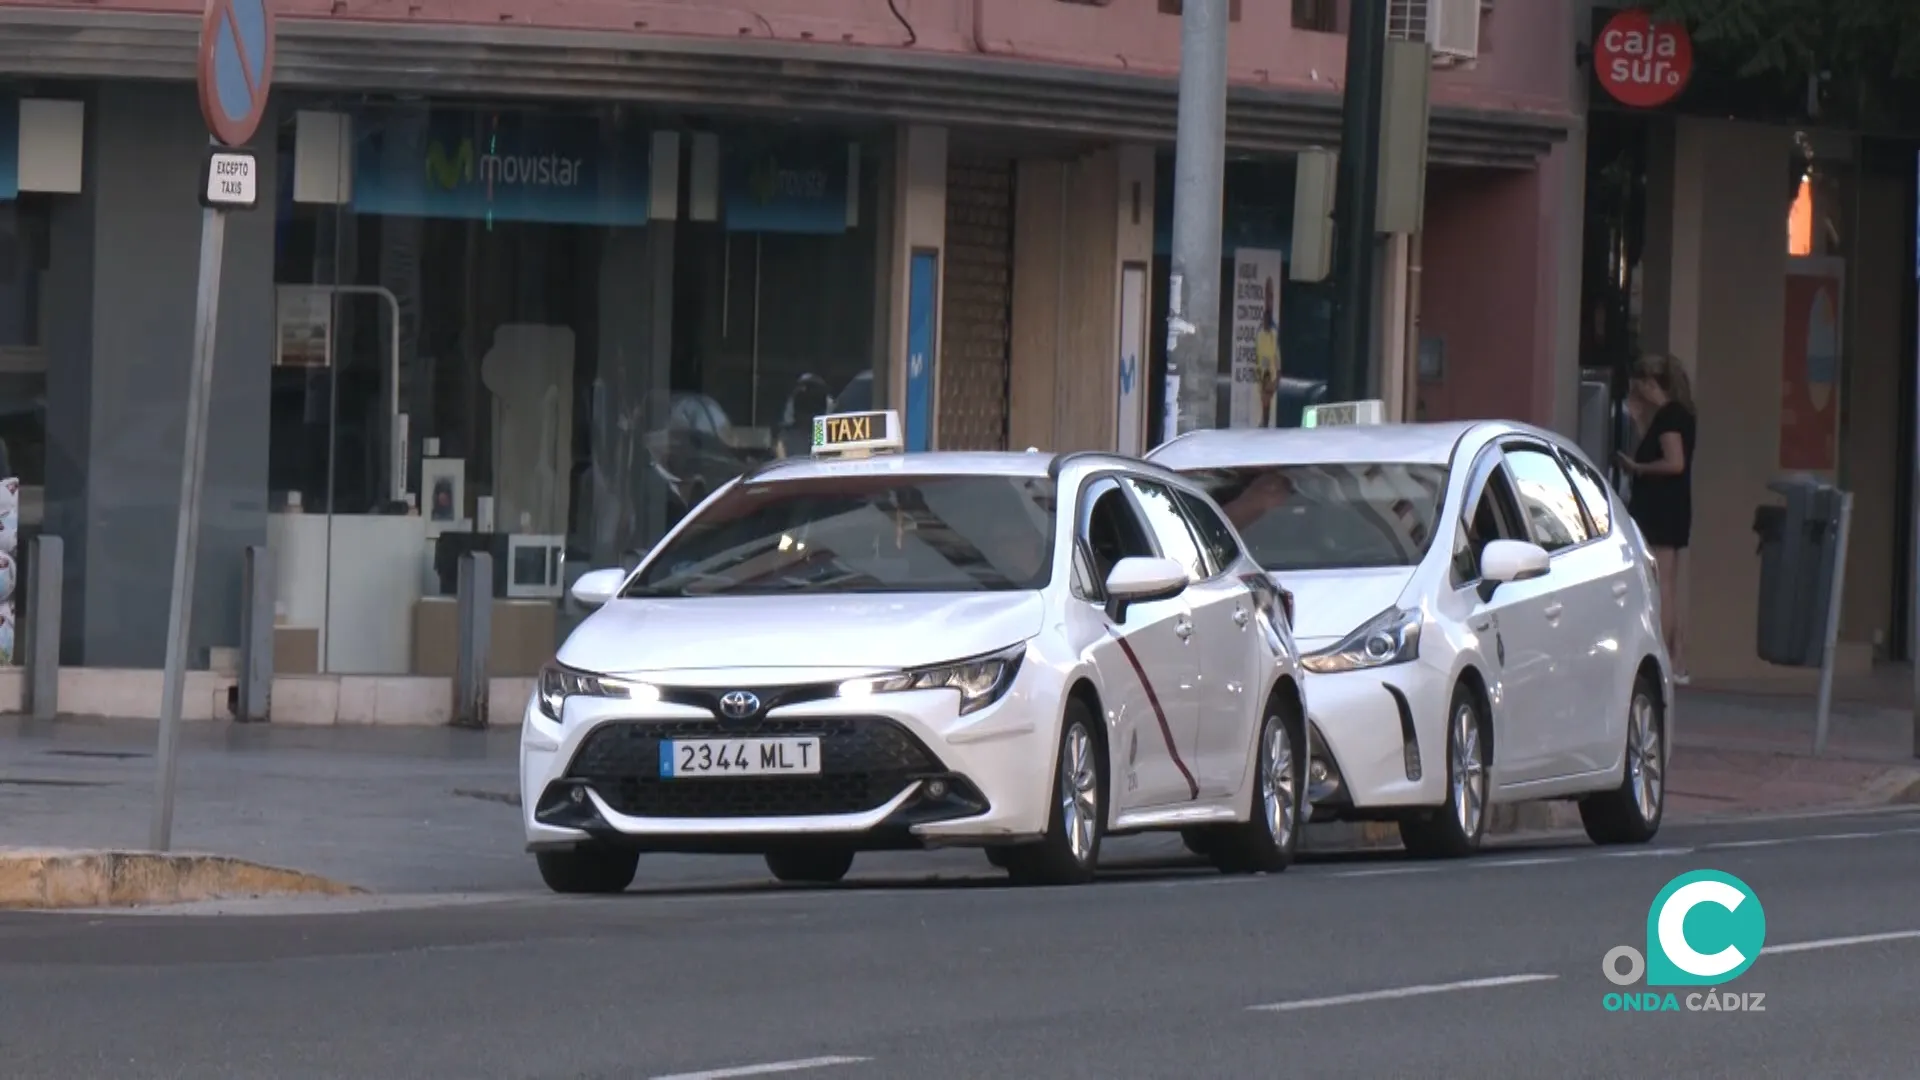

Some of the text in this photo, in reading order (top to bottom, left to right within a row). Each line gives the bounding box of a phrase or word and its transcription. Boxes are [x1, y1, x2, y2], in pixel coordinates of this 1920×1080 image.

[1604, 24, 1676, 61] caja
[216, 160, 249, 177] EXCEPTO
[480, 153, 582, 186] movistar
[221, 180, 242, 195] TAXIS
[827, 416, 871, 443] TAXI
[680, 742, 812, 772] 2344 MLT
